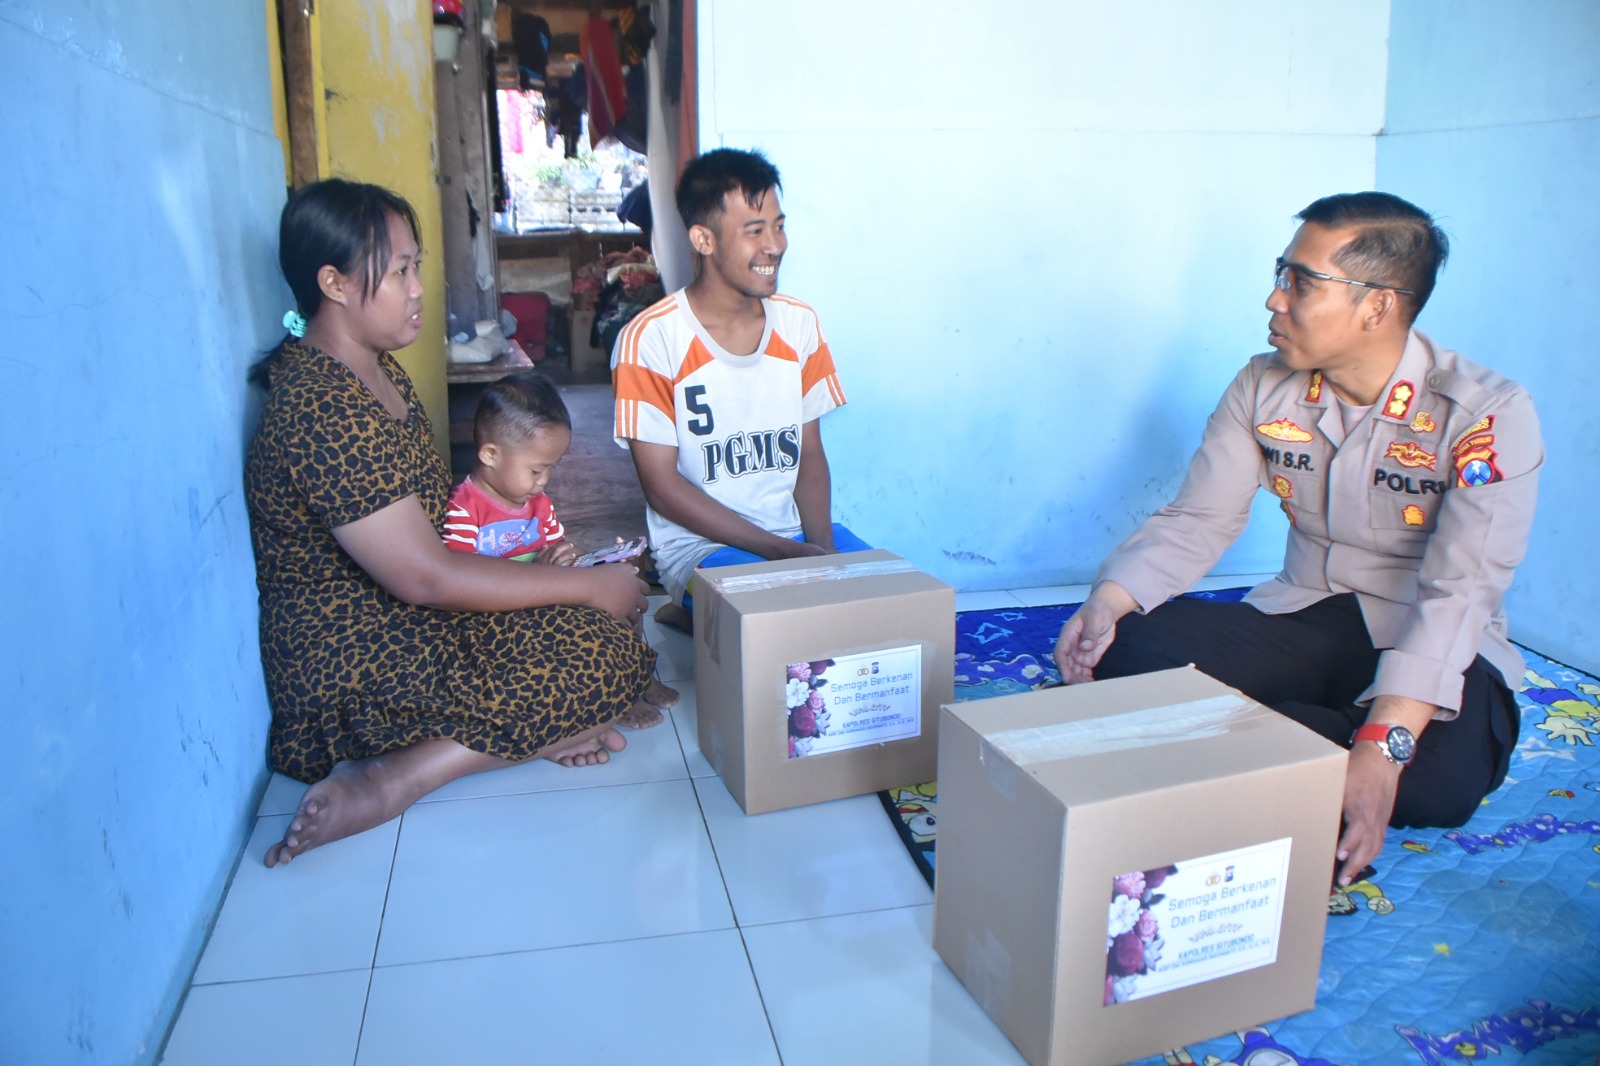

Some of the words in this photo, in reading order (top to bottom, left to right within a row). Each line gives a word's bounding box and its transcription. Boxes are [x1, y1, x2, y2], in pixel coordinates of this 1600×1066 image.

[684, 384, 715, 436] 5
[702, 424, 801, 484] PGMS
[1283, 451, 1314, 471] S.R.
[831, 680, 868, 693] Semoga
[870, 672, 913, 687] Berkenan
[834, 694, 852, 705] Dan
[855, 685, 910, 702] Bermanfaat
[842, 716, 871, 728] KAPOLRES
[1168, 892, 1218, 912] Semoga
[1221, 877, 1277, 899] Berkenan
[1171, 914, 1195, 929] Dan
[1199, 895, 1270, 923] Bermanfaat
[1178, 943, 1215, 960] KAPOLRES
